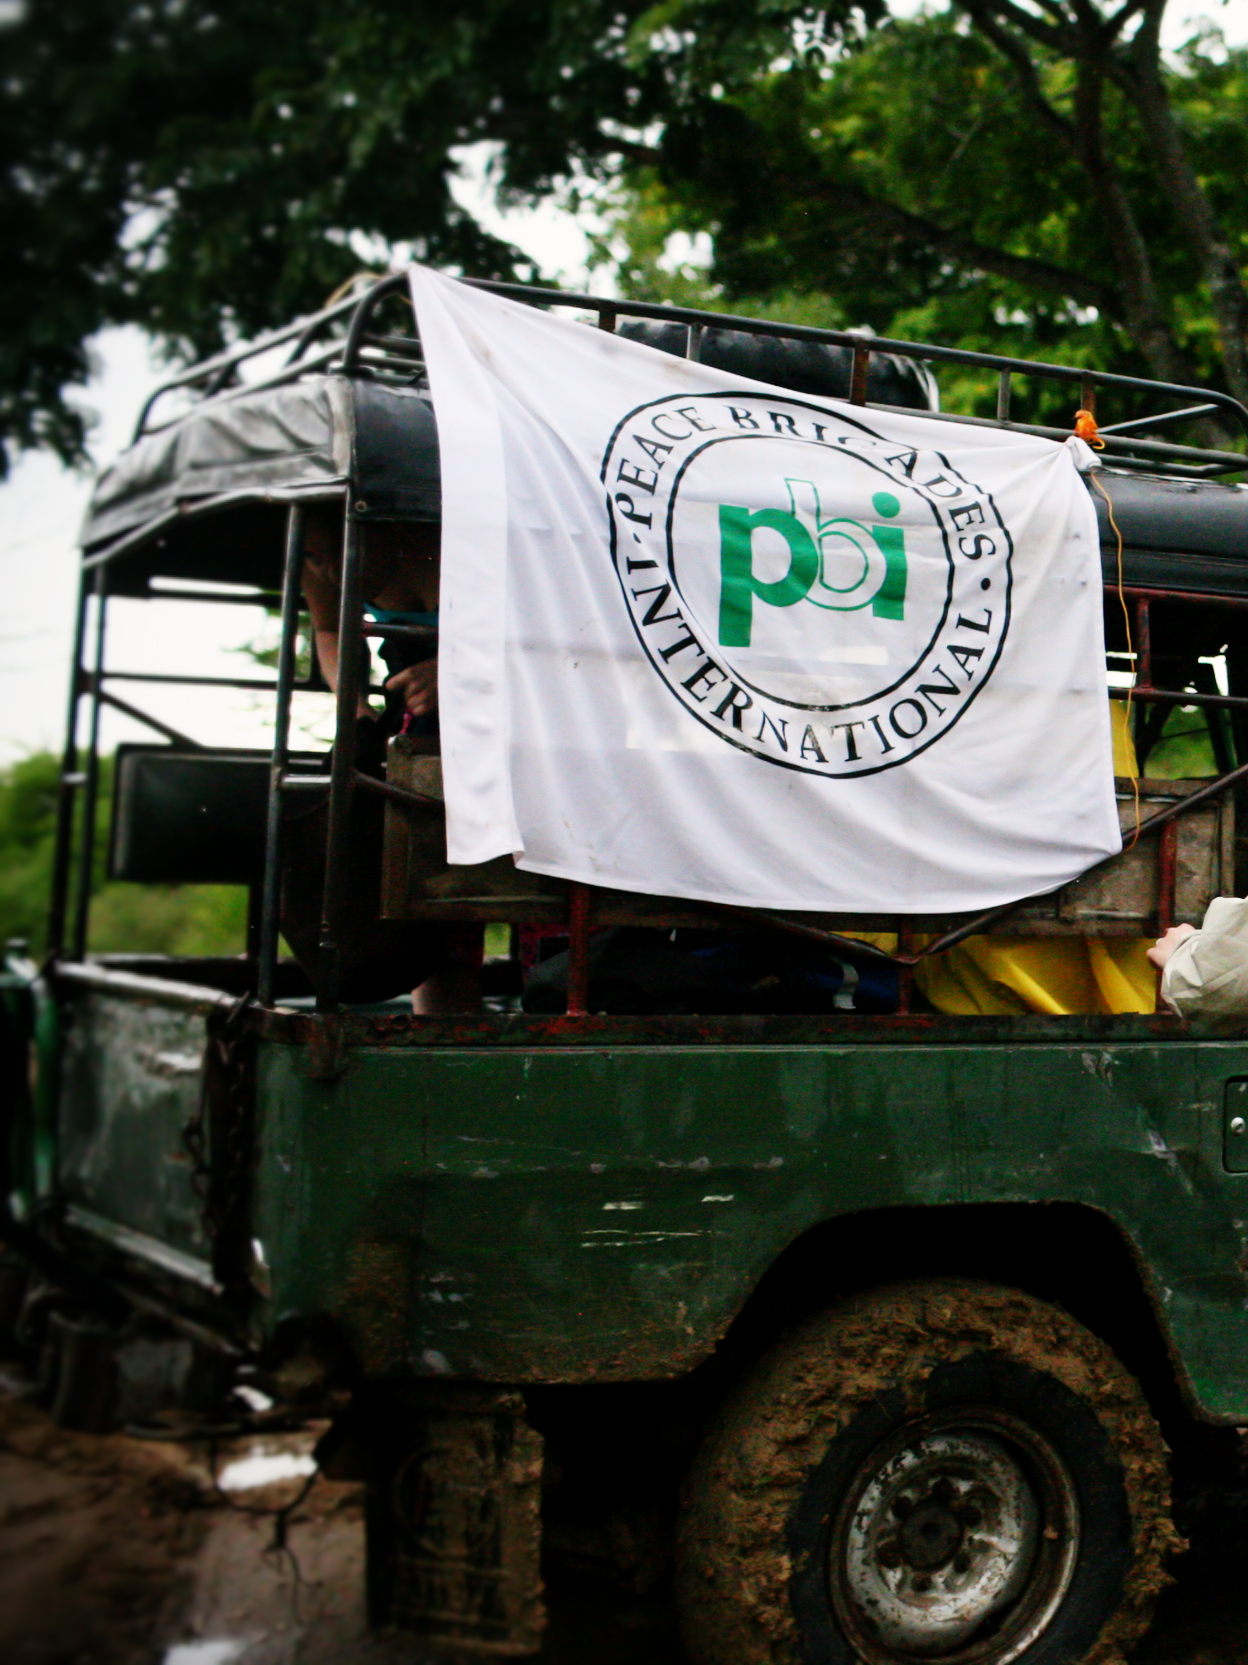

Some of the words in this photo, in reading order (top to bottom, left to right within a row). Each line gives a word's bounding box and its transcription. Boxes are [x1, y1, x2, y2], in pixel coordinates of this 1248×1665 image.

[614, 406, 717, 530] PEACE
[718, 477, 908, 648] pbi
[626, 555, 993, 763] INTERNATIONAL
